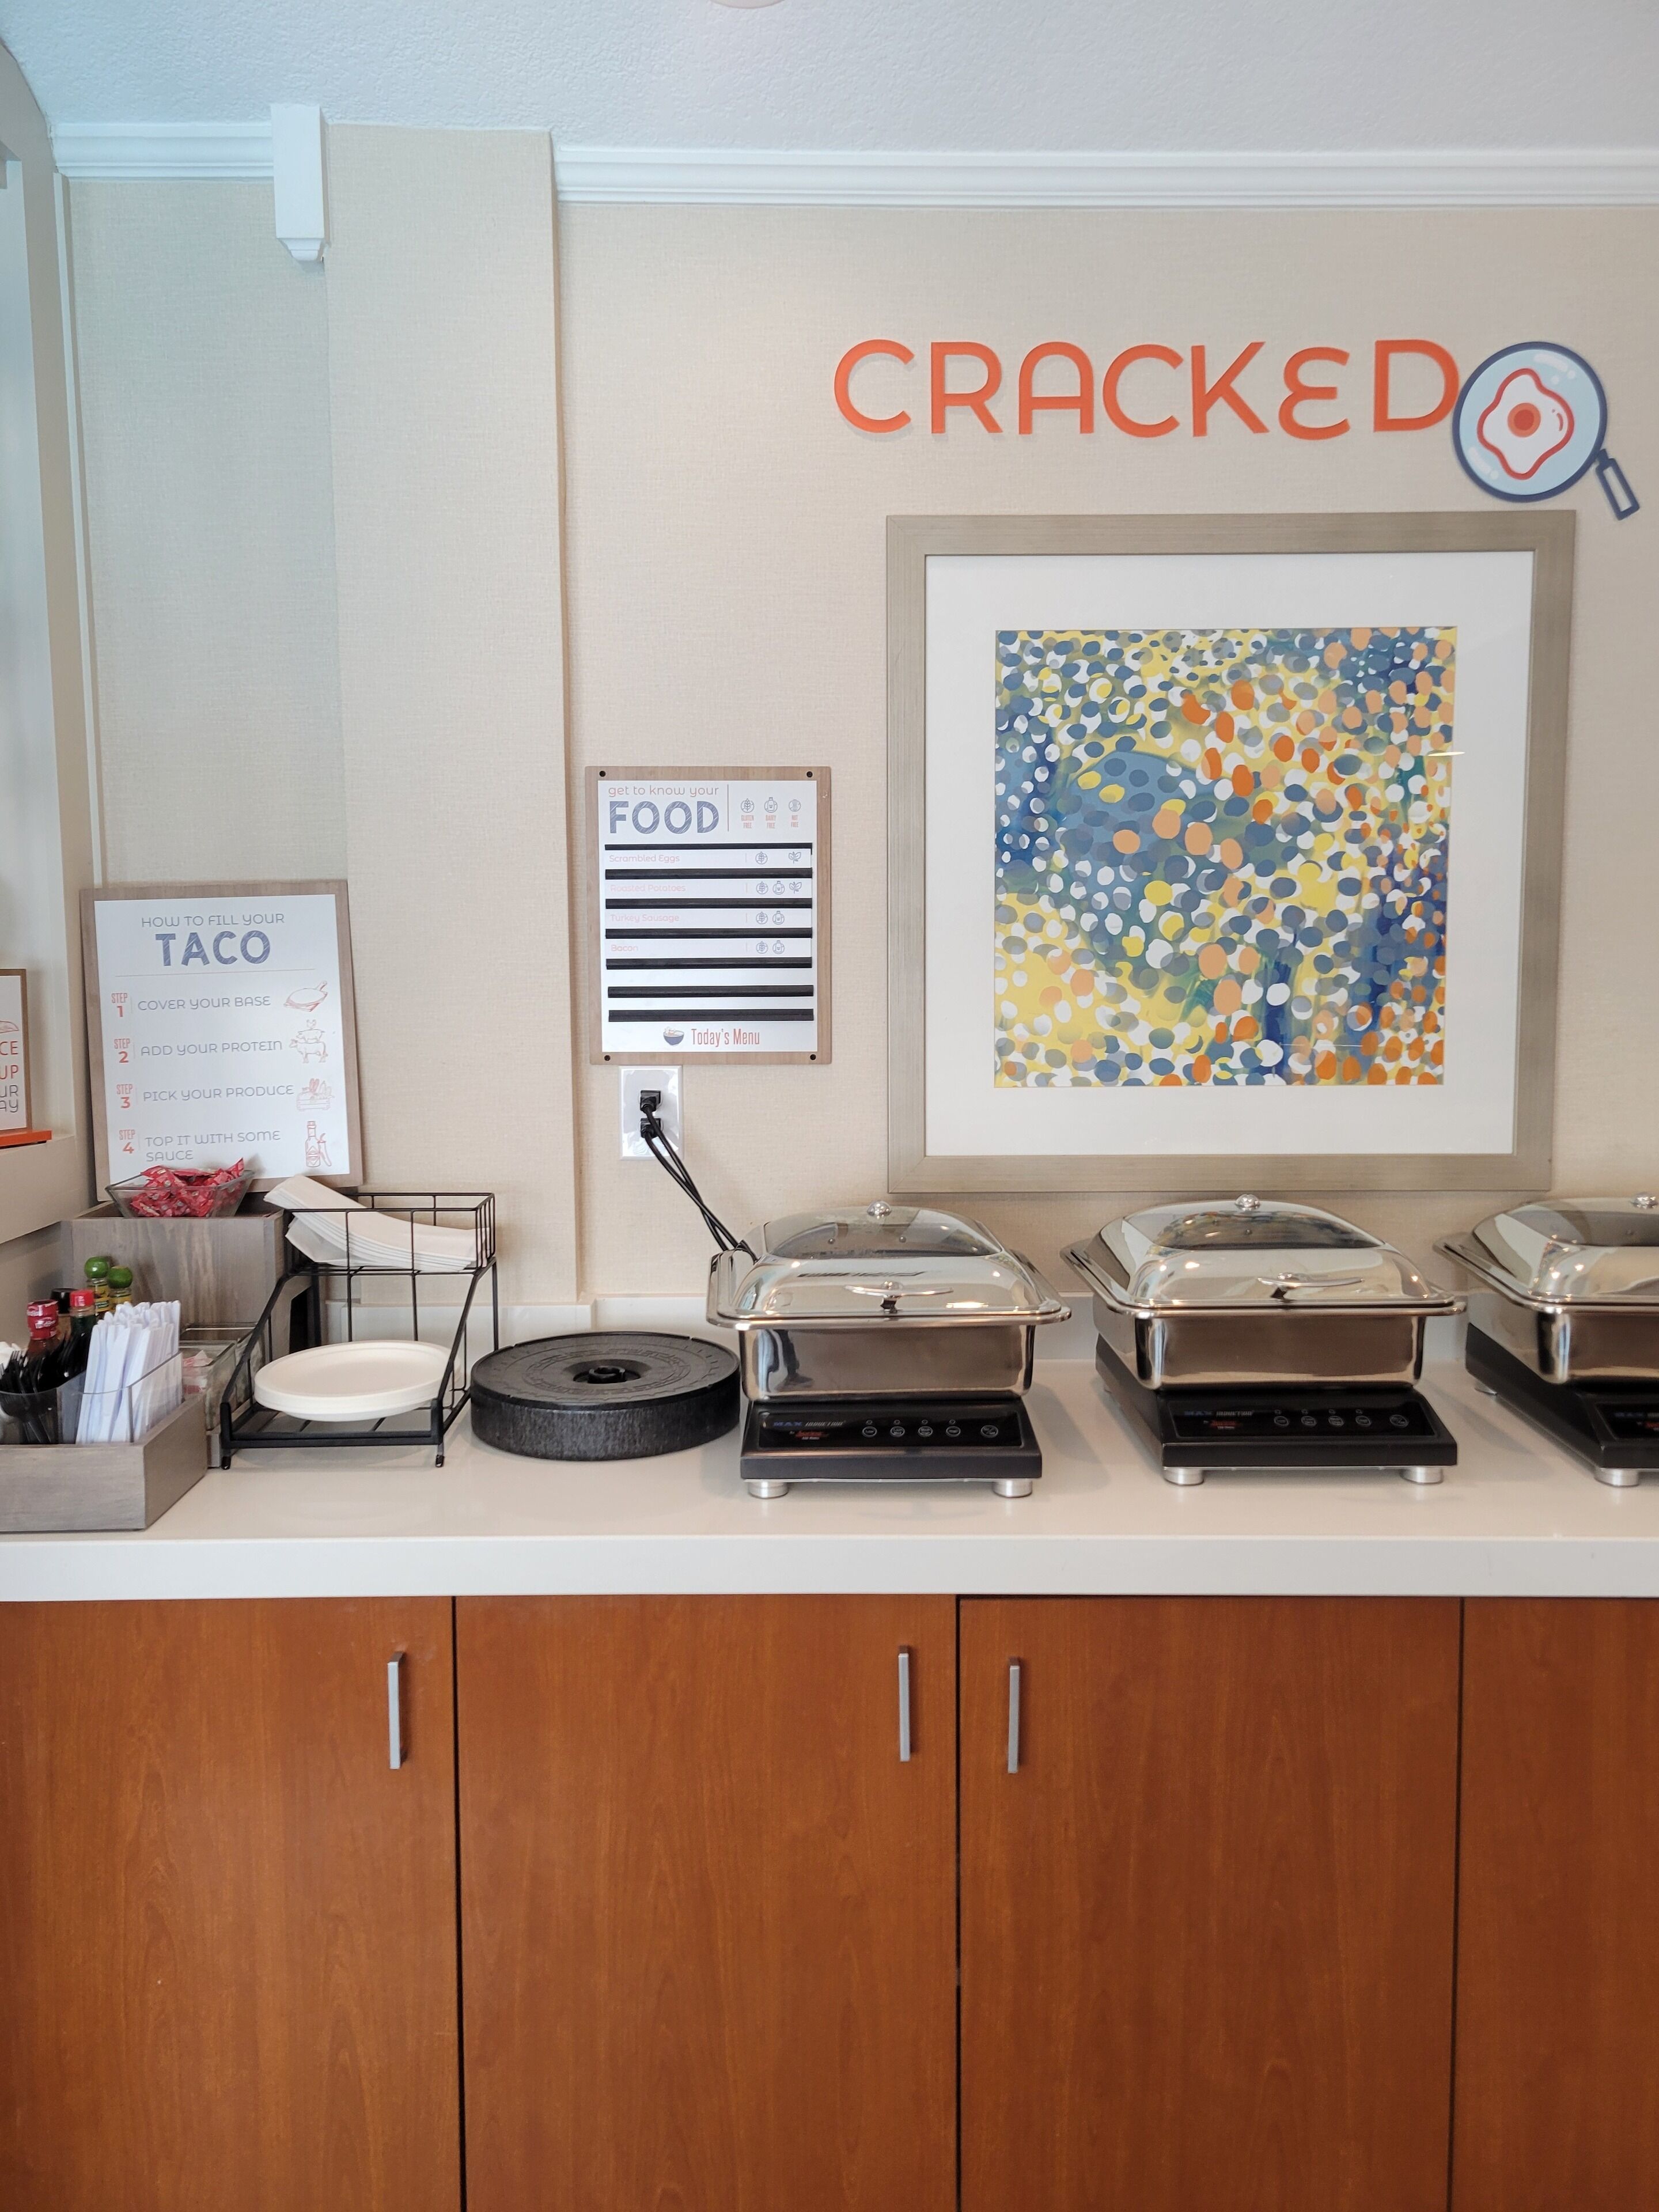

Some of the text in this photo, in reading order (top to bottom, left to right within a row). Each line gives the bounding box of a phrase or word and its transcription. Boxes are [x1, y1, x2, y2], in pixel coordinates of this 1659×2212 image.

[833, 338, 1460, 441] CRACKED
[608, 785, 719, 797] get to know your
[609, 801, 719, 835] FOOD
[609, 854, 680, 863] Scrambled Eggs
[610, 884, 646, 892] Roasted
[141, 913, 285, 928] HOW TO FILL YOUR
[611, 914, 680, 923] Turkey Sausage
[155, 930, 271, 967] TACO
[111, 992, 128, 1004] STEP
[138, 995, 271, 1011] COVER YOUR BASE
[116, 1005, 124, 1018] 1
[691, 1028, 760, 1047] Today's Menu
[113, 1038, 130, 1050] STEP
[141, 1040, 283, 1056] ADD YOUR PROTEIN
[119, 1051, 130, 1063] 2
[116, 1084, 133, 1095] STEP
[143, 1085, 294, 1102] PICK YOUR PRODUCE
[120, 1097, 131, 1109] 3
[119, 1129, 136, 1141] STEP
[145, 1130, 281, 1147] TOP IT WITH SOME
[122, 1142, 135, 1154] 4
[146, 1150, 194, 1162] SAUCE
